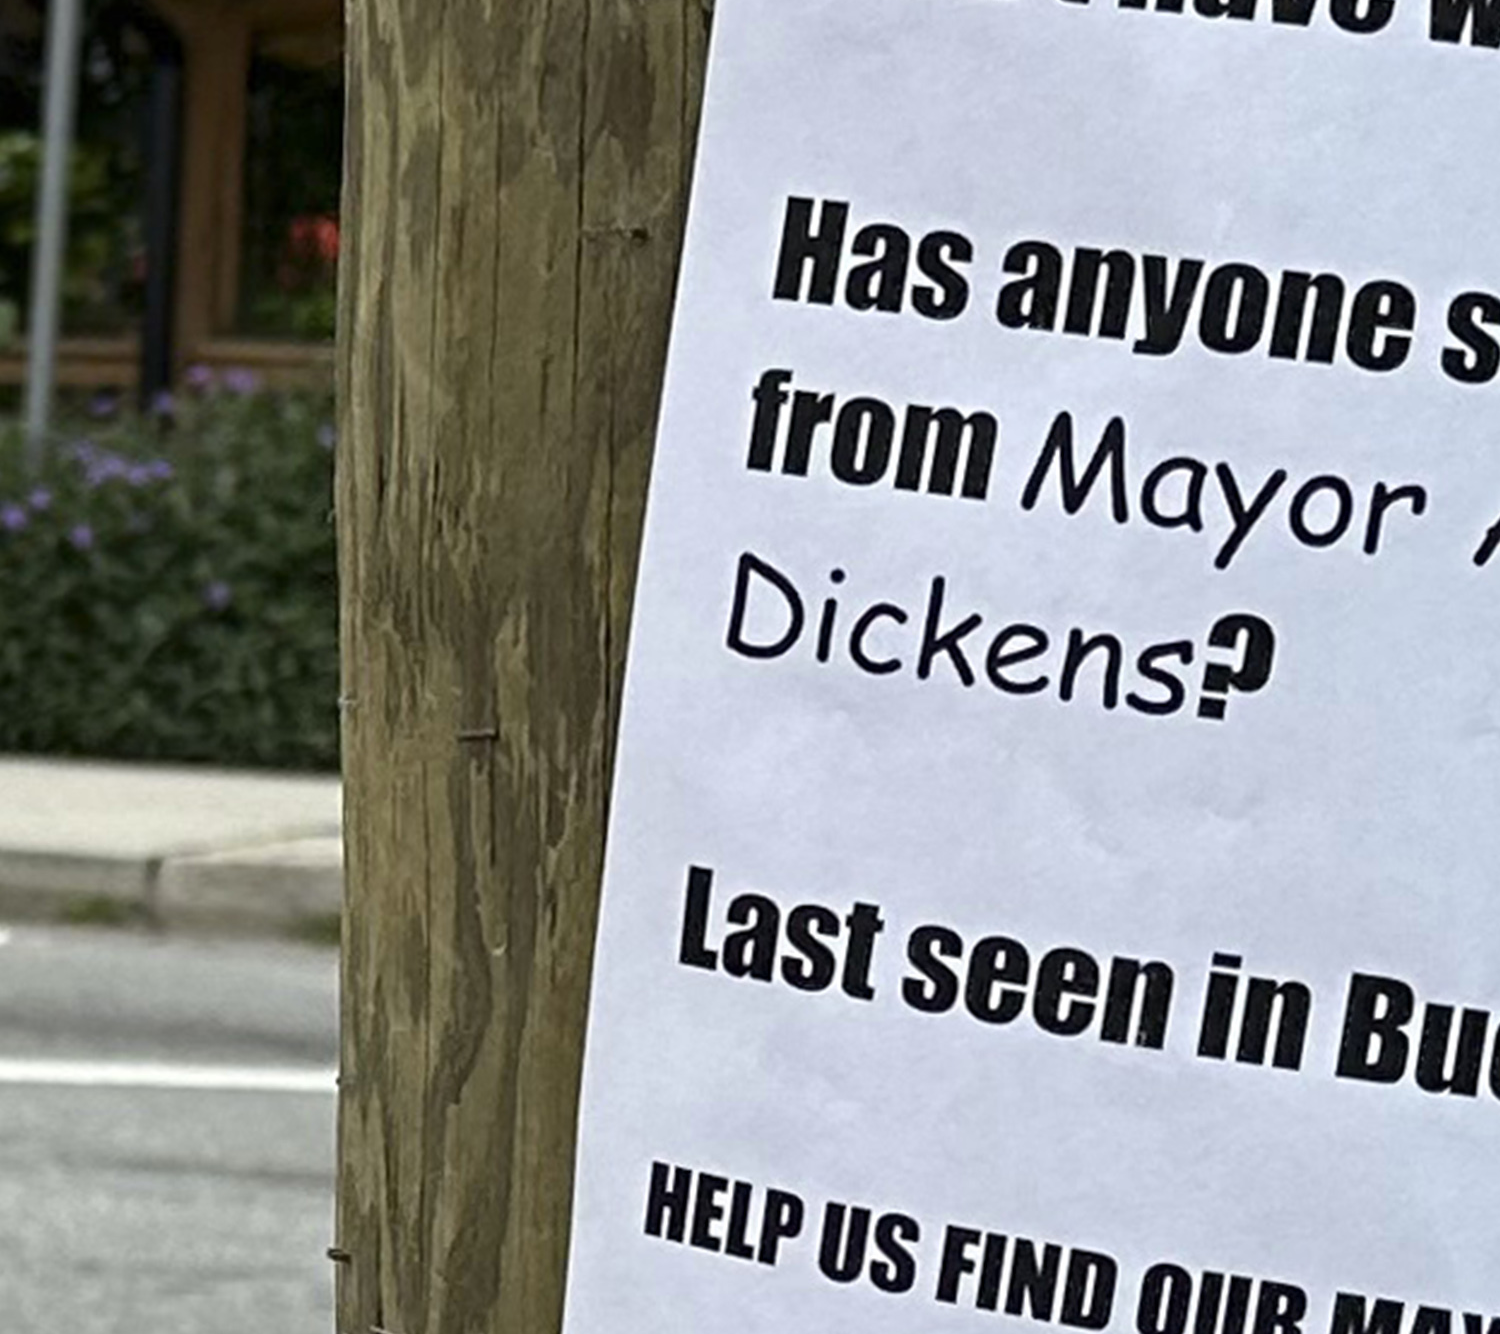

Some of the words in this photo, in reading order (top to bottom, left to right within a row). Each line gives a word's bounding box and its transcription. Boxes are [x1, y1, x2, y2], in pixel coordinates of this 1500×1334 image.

[772, 195, 974, 321] Has
[995, 239, 1417, 373] anyone
[745, 367, 998, 501] from
[1020, 410, 1430, 577] Mayor
[724, 549, 1278, 723] Dickens?
[678, 863, 886, 1003] Last
[901, 924, 1176, 1051] seen
[1196, 951, 1312, 1073] in
[643, 1160, 805, 1267] HELP
[817, 1201, 921, 1294] US
[934, 1223, 1119, 1331] FIND
